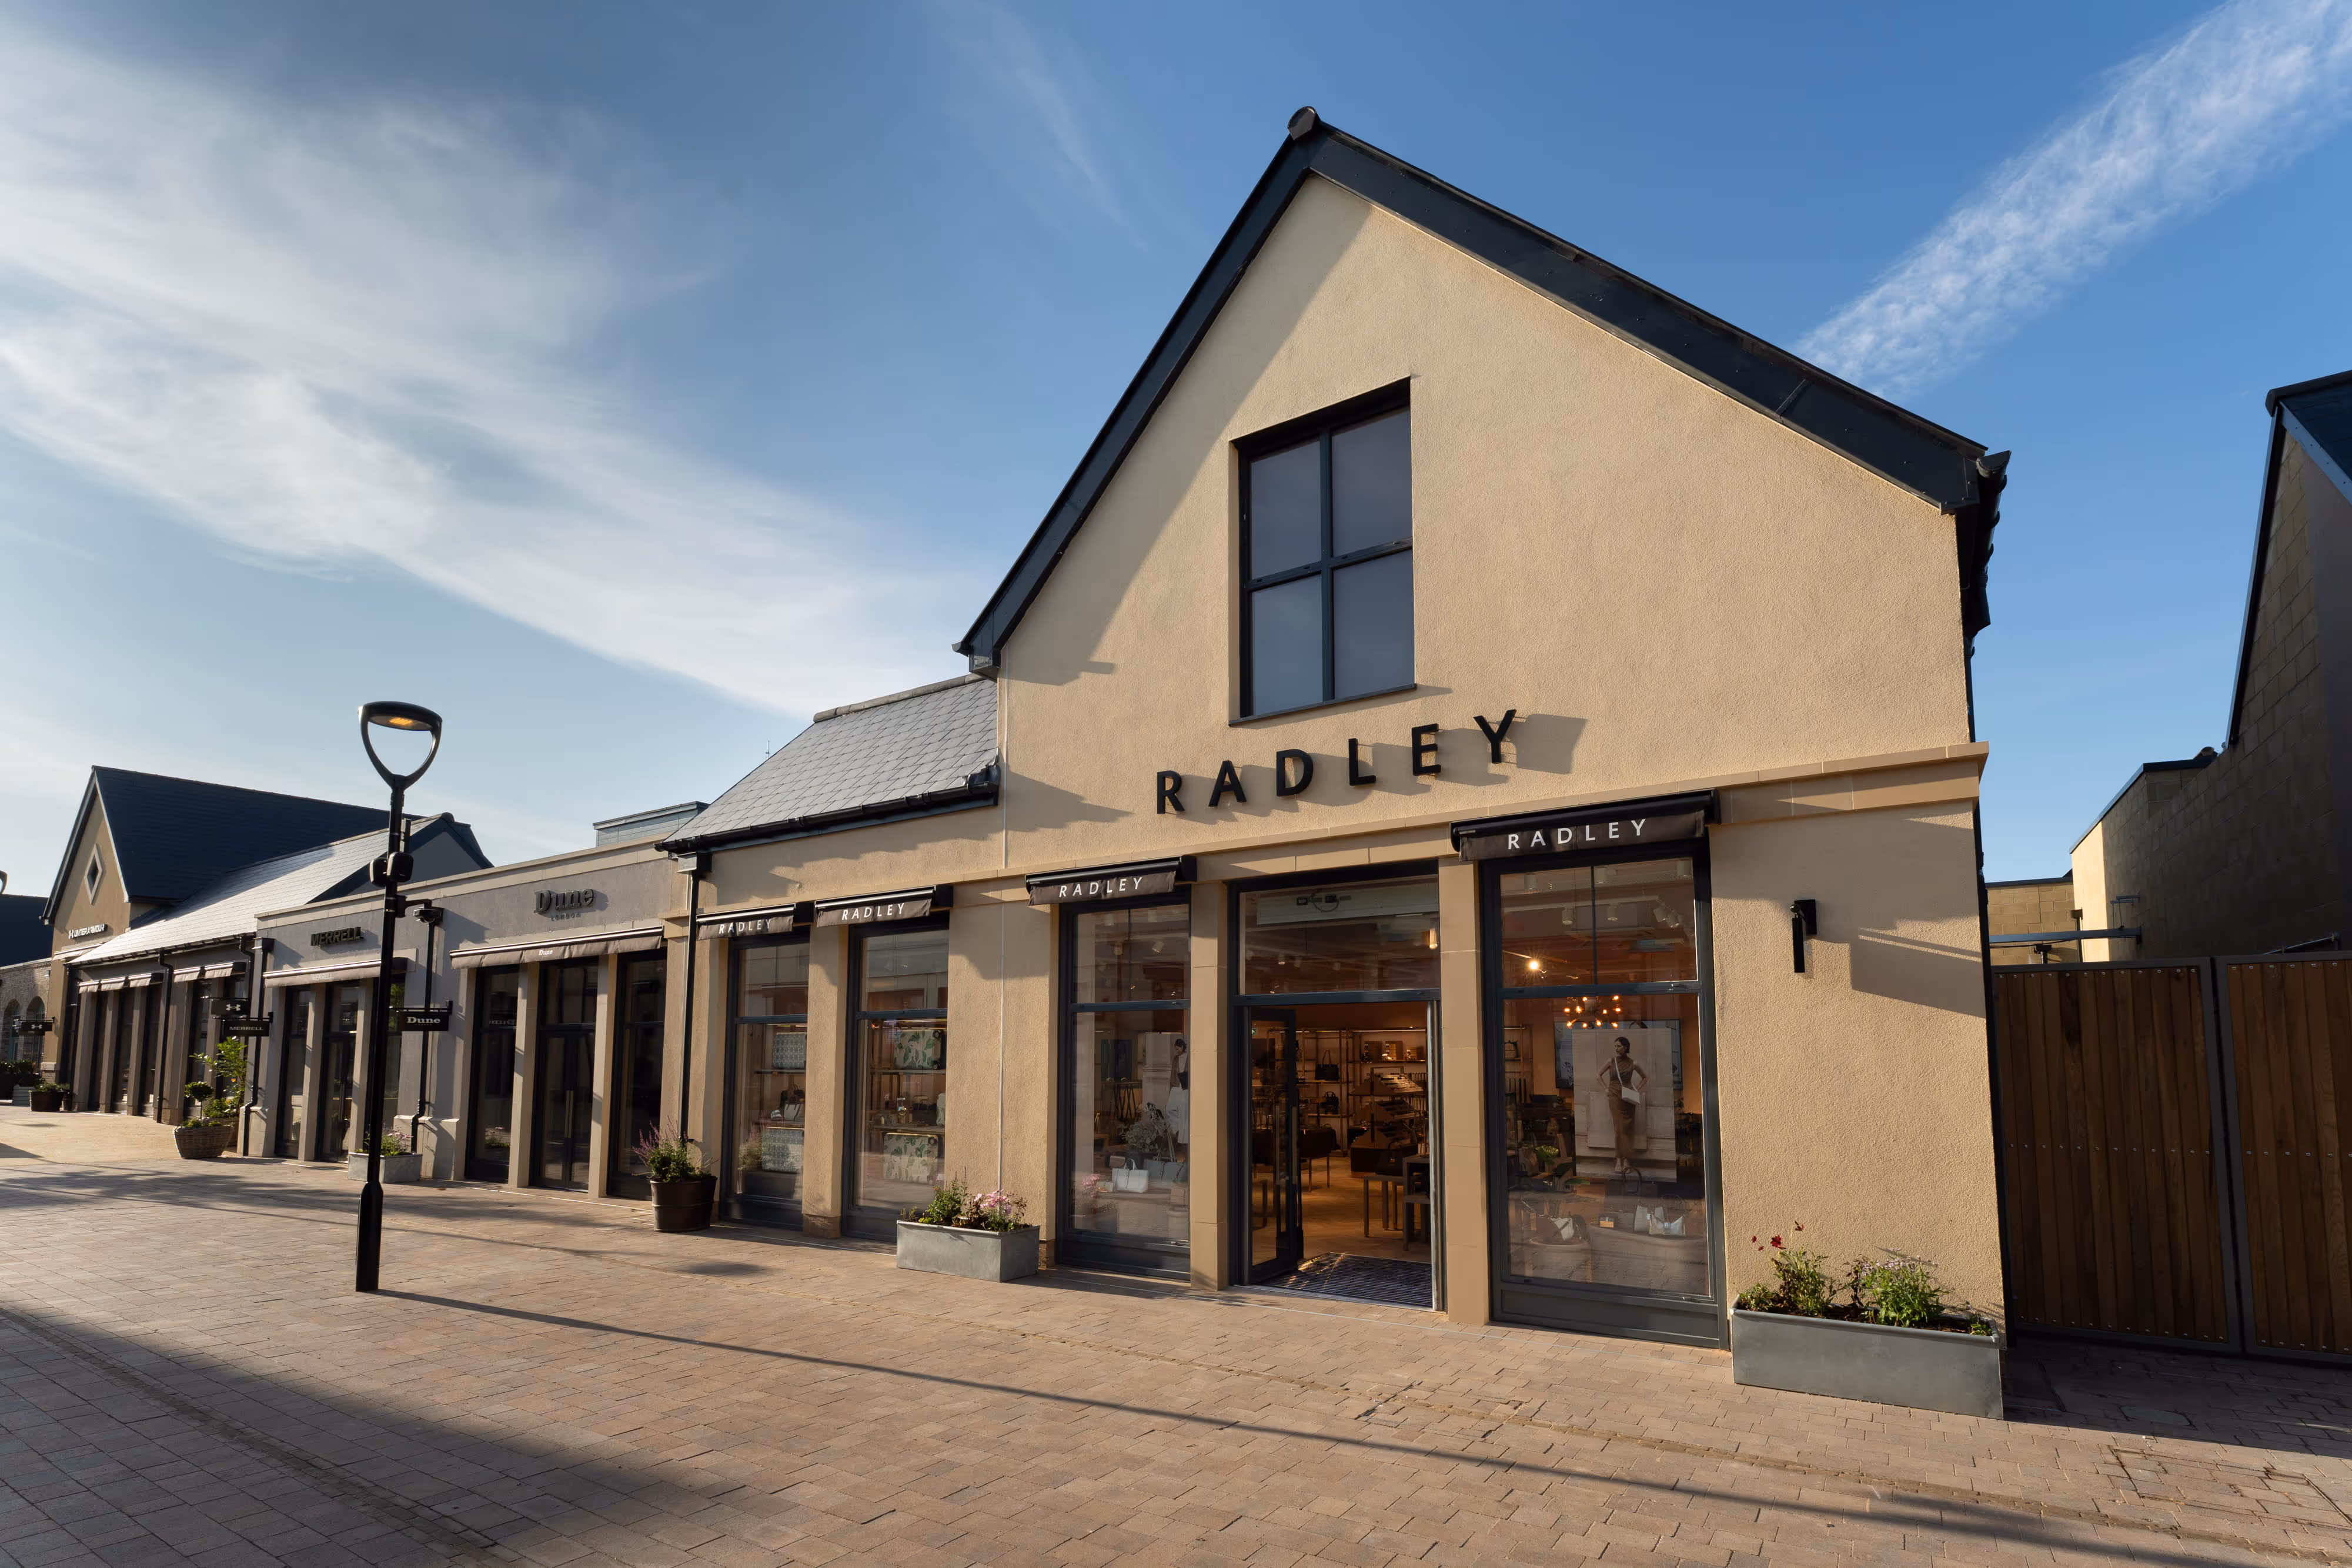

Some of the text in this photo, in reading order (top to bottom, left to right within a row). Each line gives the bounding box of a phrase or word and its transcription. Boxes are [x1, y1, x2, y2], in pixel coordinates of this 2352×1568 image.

[1157, 709, 1516, 814] RADLEY
[1508, 819, 1646, 850] RADLEY
[1059, 877, 1142, 898] RADLEY
[534, 888, 594, 914] Dune
[842, 902, 904, 921] RADLEY
[310, 927, 364, 946] MERRELL
[719, 918, 771, 934] RADLEY
